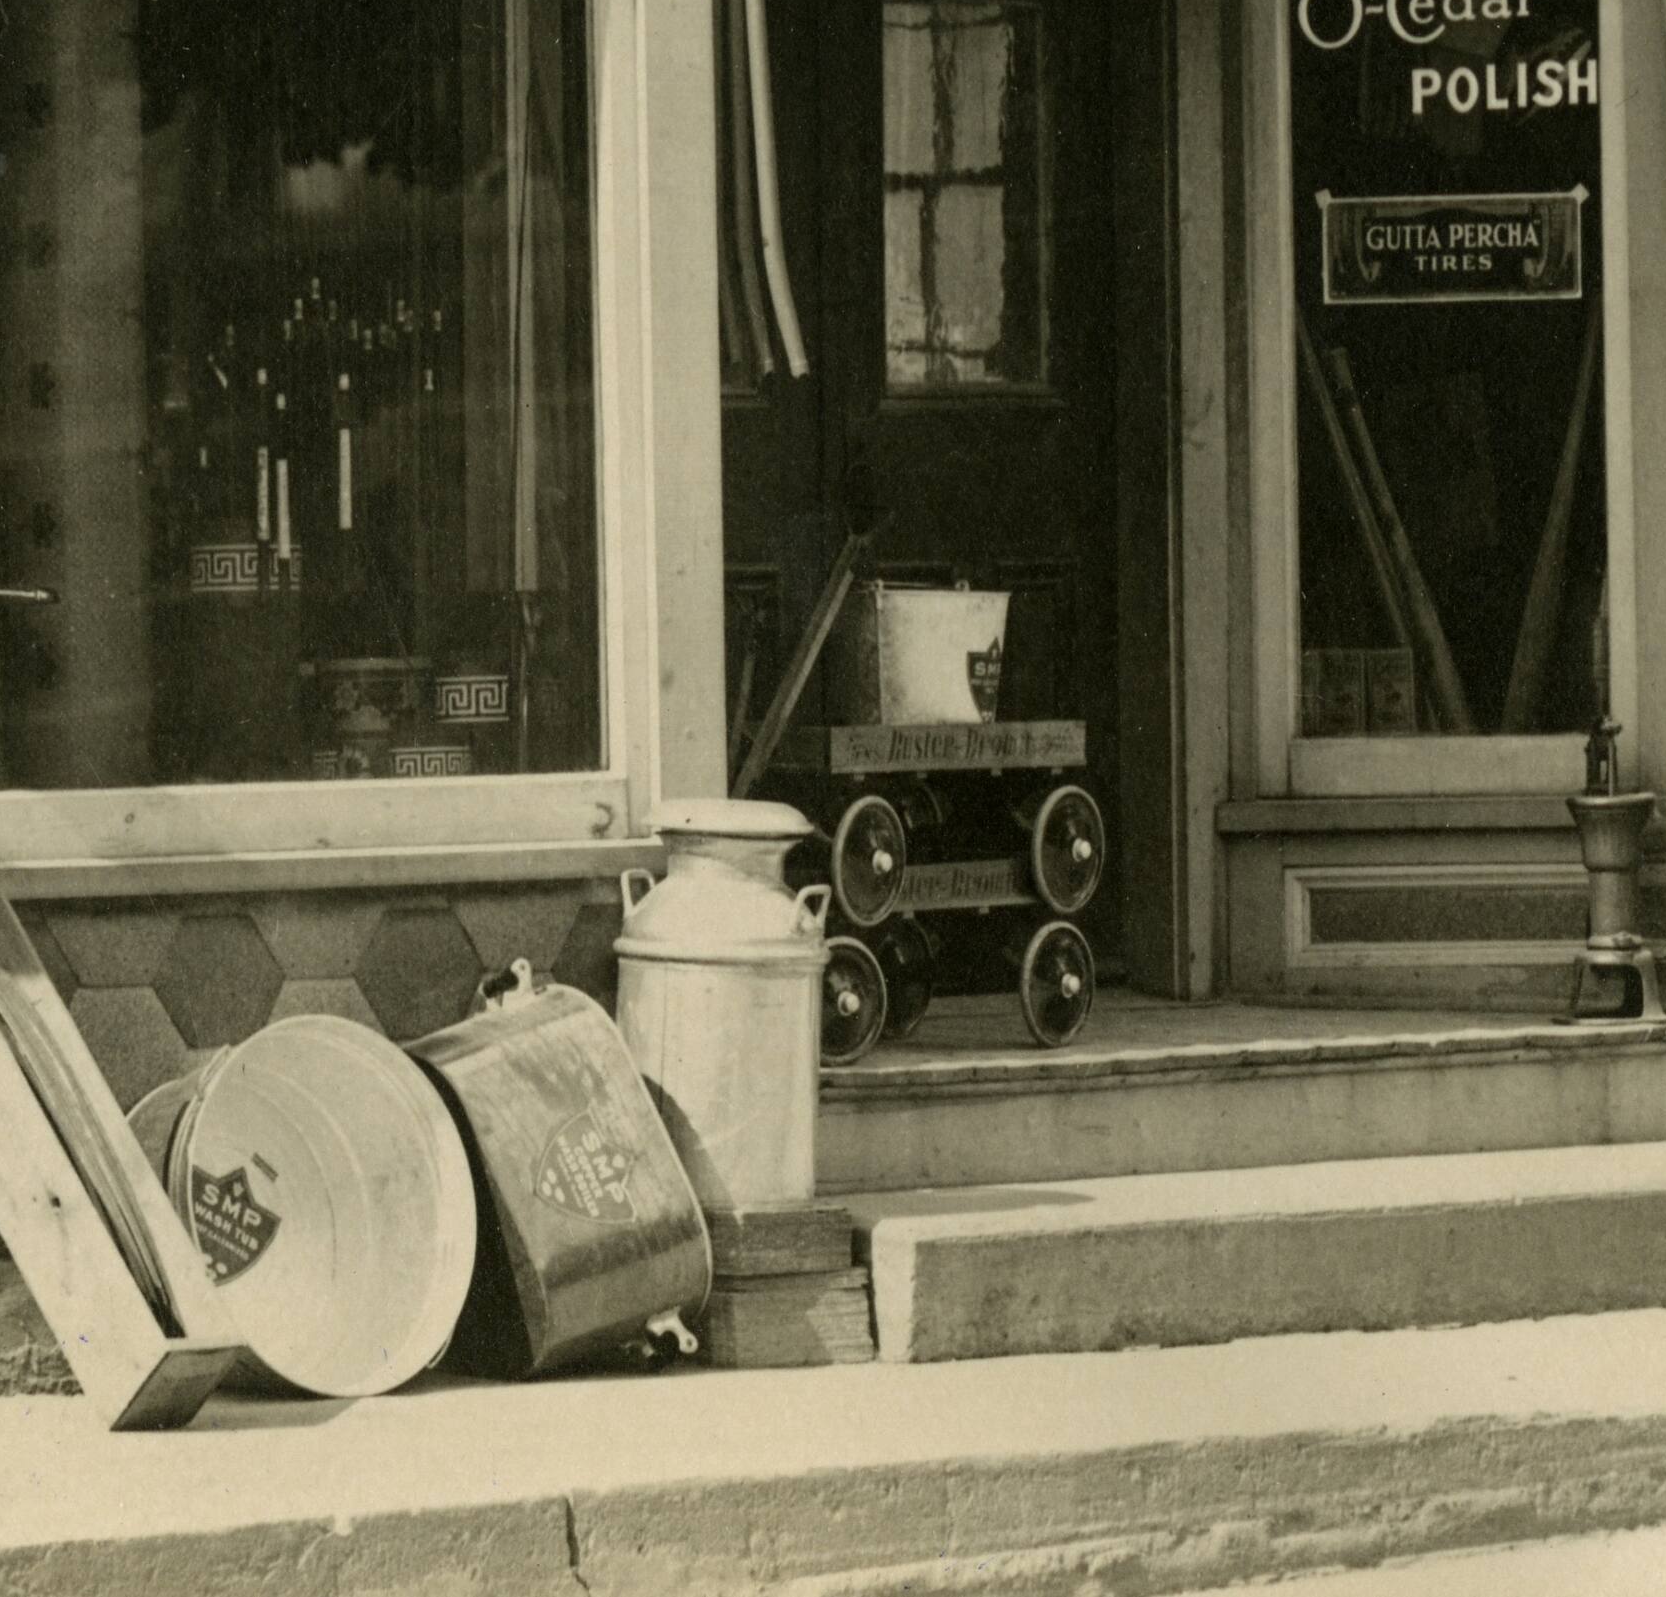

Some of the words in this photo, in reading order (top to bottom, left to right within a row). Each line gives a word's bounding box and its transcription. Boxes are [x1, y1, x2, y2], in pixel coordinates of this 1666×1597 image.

[1411, 59, 1597, 114] POLISH
[1414, 255, 1493, 271] TIRES
[974, 661, 1001, 677] SM
[573, 1146, 604, 1199] COPPER
[581, 1130, 625, 1205] SMP
[194, 1201, 232, 1235] WASH
[234, 1225, 260, 1252] TUB
[201, 1183, 263, 1228] SMP
